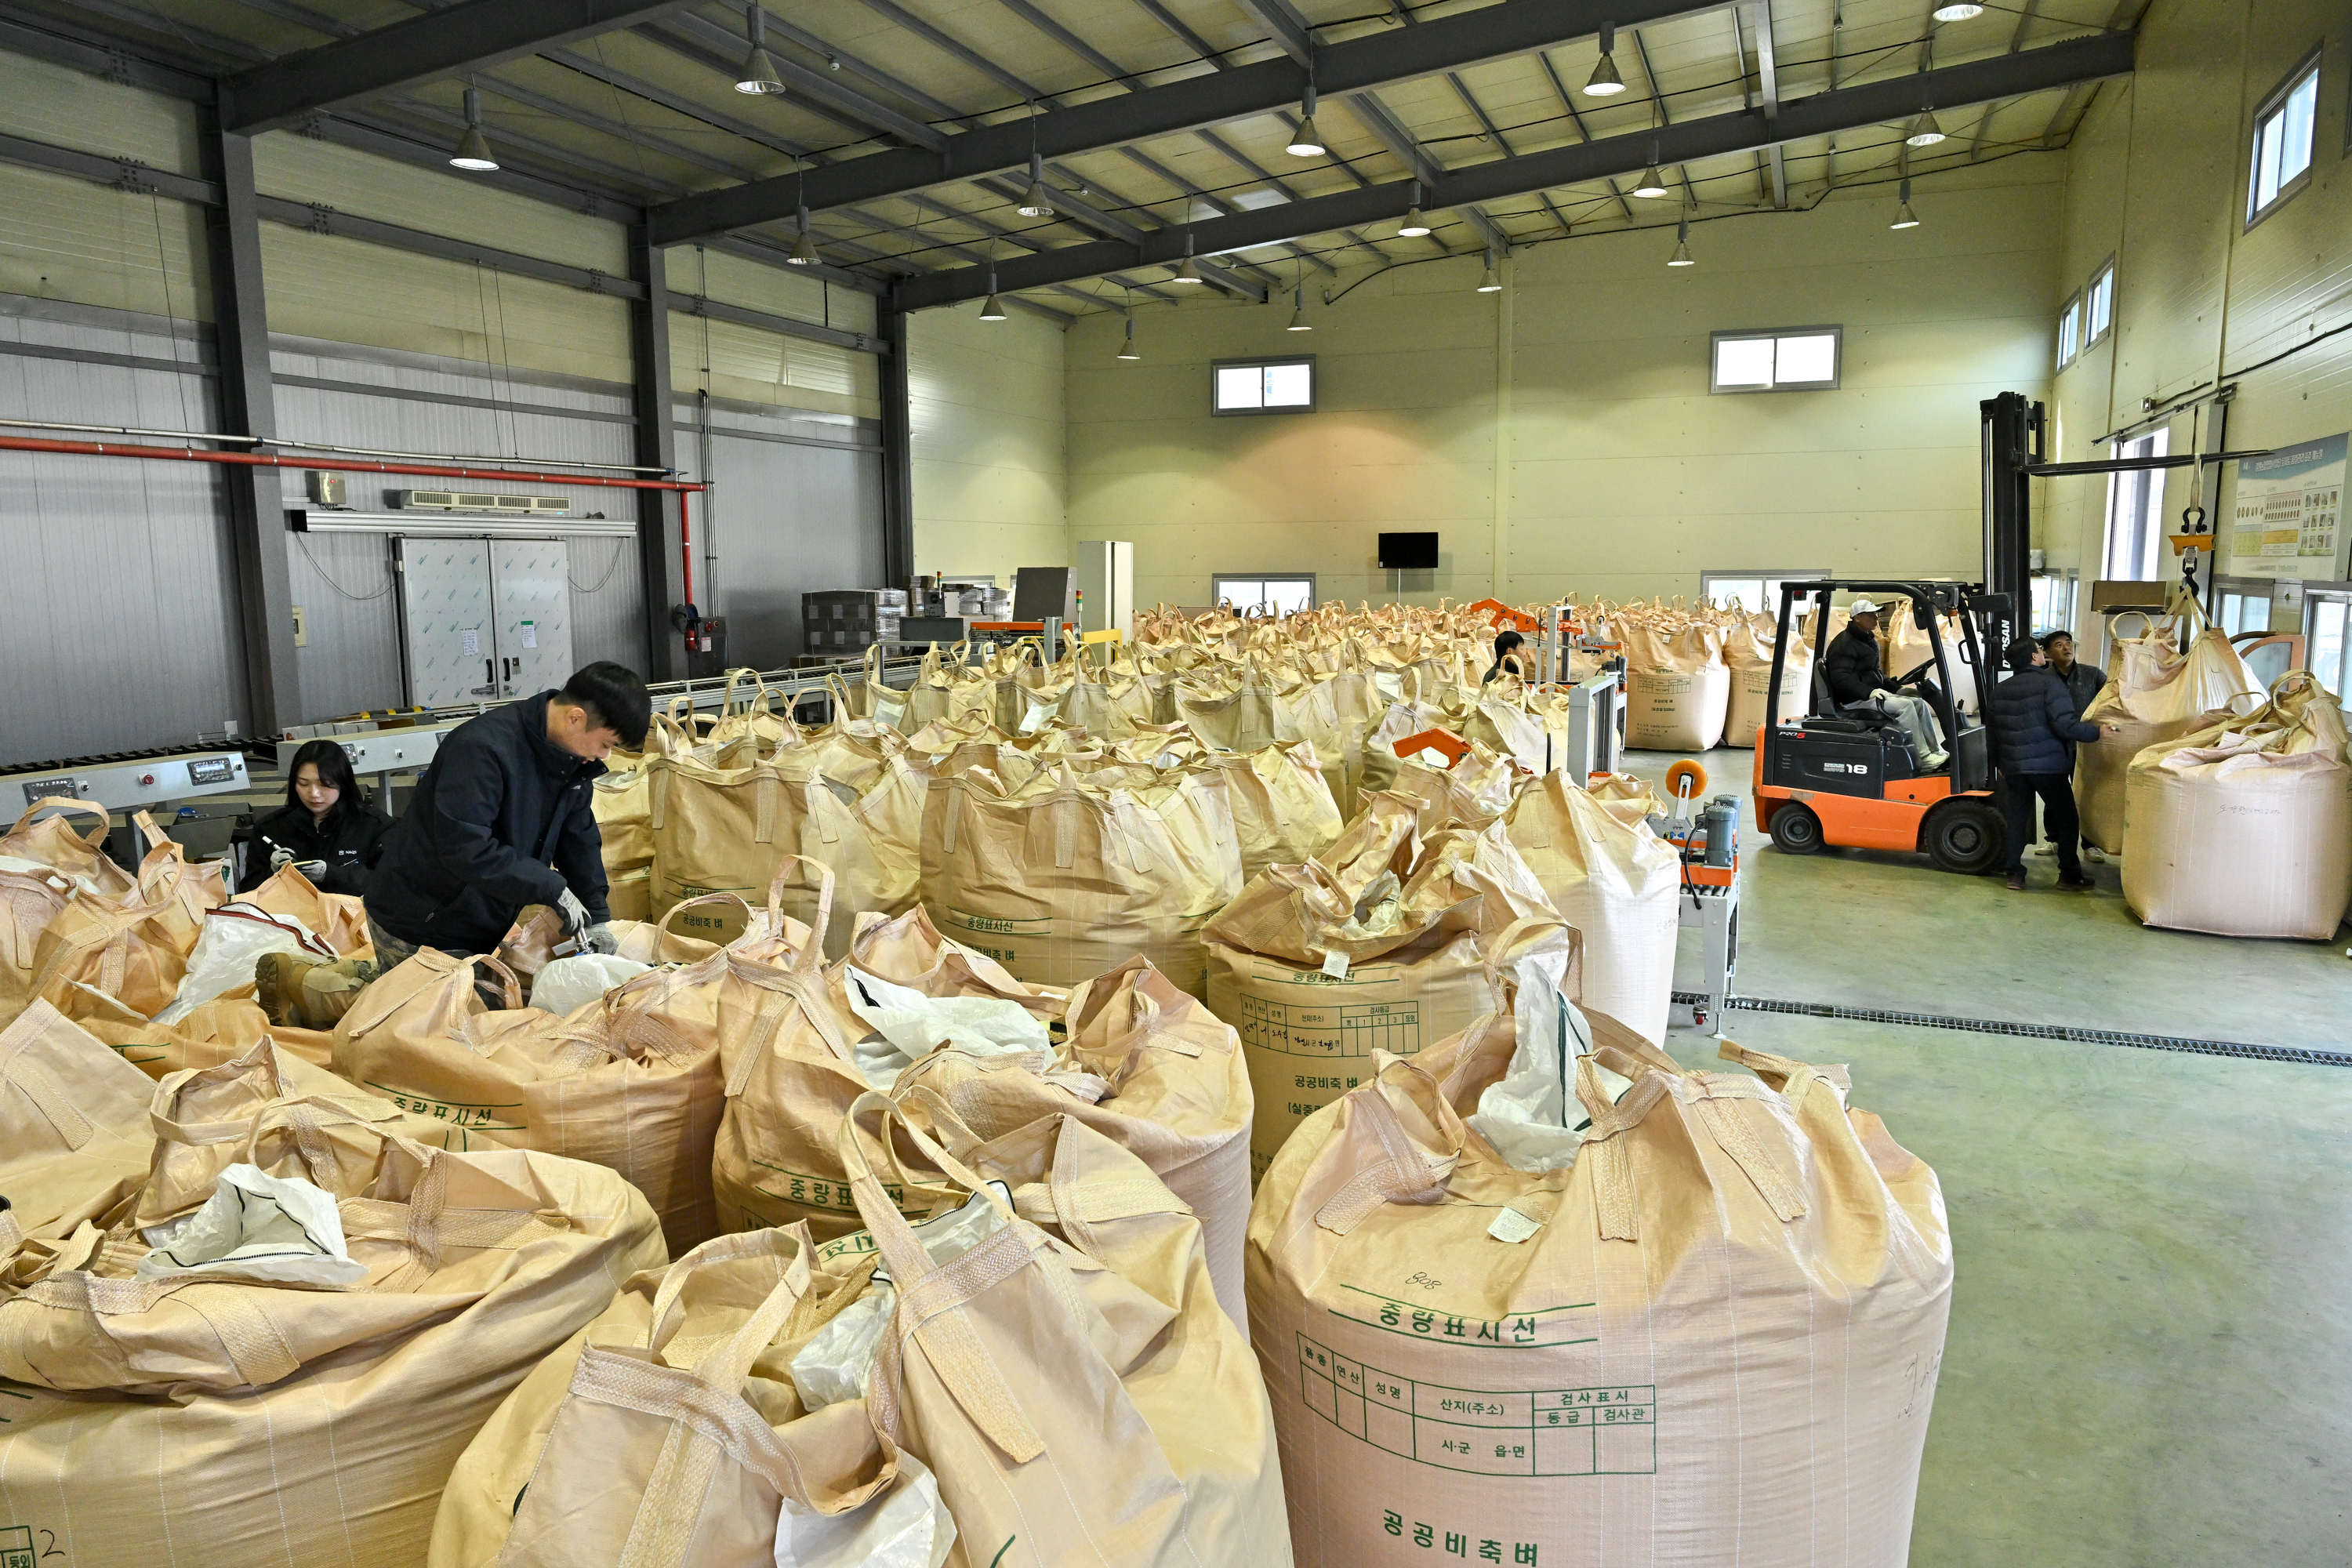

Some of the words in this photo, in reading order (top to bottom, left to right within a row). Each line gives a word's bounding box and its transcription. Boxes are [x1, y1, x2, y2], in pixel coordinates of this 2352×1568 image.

[1846, 764, 1868, 775] 18
[683, 913, 711, 928] 공공비축
[714, 918, 723, 929] 벼
[967, 916, 1014, 932] 중량표시선
[1005, 950, 1014, 962] 벼
[1272, 1009, 1282, 1018] 성명
[1301, 1014, 1324, 1023] 산지(주소)
[1294, 1075, 1341, 1090] 공공비축
[1346, 1077, 1358, 1089] 벼
[789, 1178, 904, 1209] 중량표선
[1379, 1302, 1537, 1343] 중량표시선
[1303, 1345, 1327, 1367] 품종
[1336, 1365, 1360, 1385] 연산
[1375, 1381, 1402, 1399] 성명
[1440, 1398, 1505, 1417] 산지(주소)
[1560, 1390, 1630, 1406] 검사표시
[1547, 1410, 1581, 1425] 등급
[1603, 1407, 1645, 1422] 검사관
[1441, 1439, 1471, 1455] 시·군
[1494, 1443, 1526, 1459] 읍·면
[40, 1530, 66, 1558] 2
